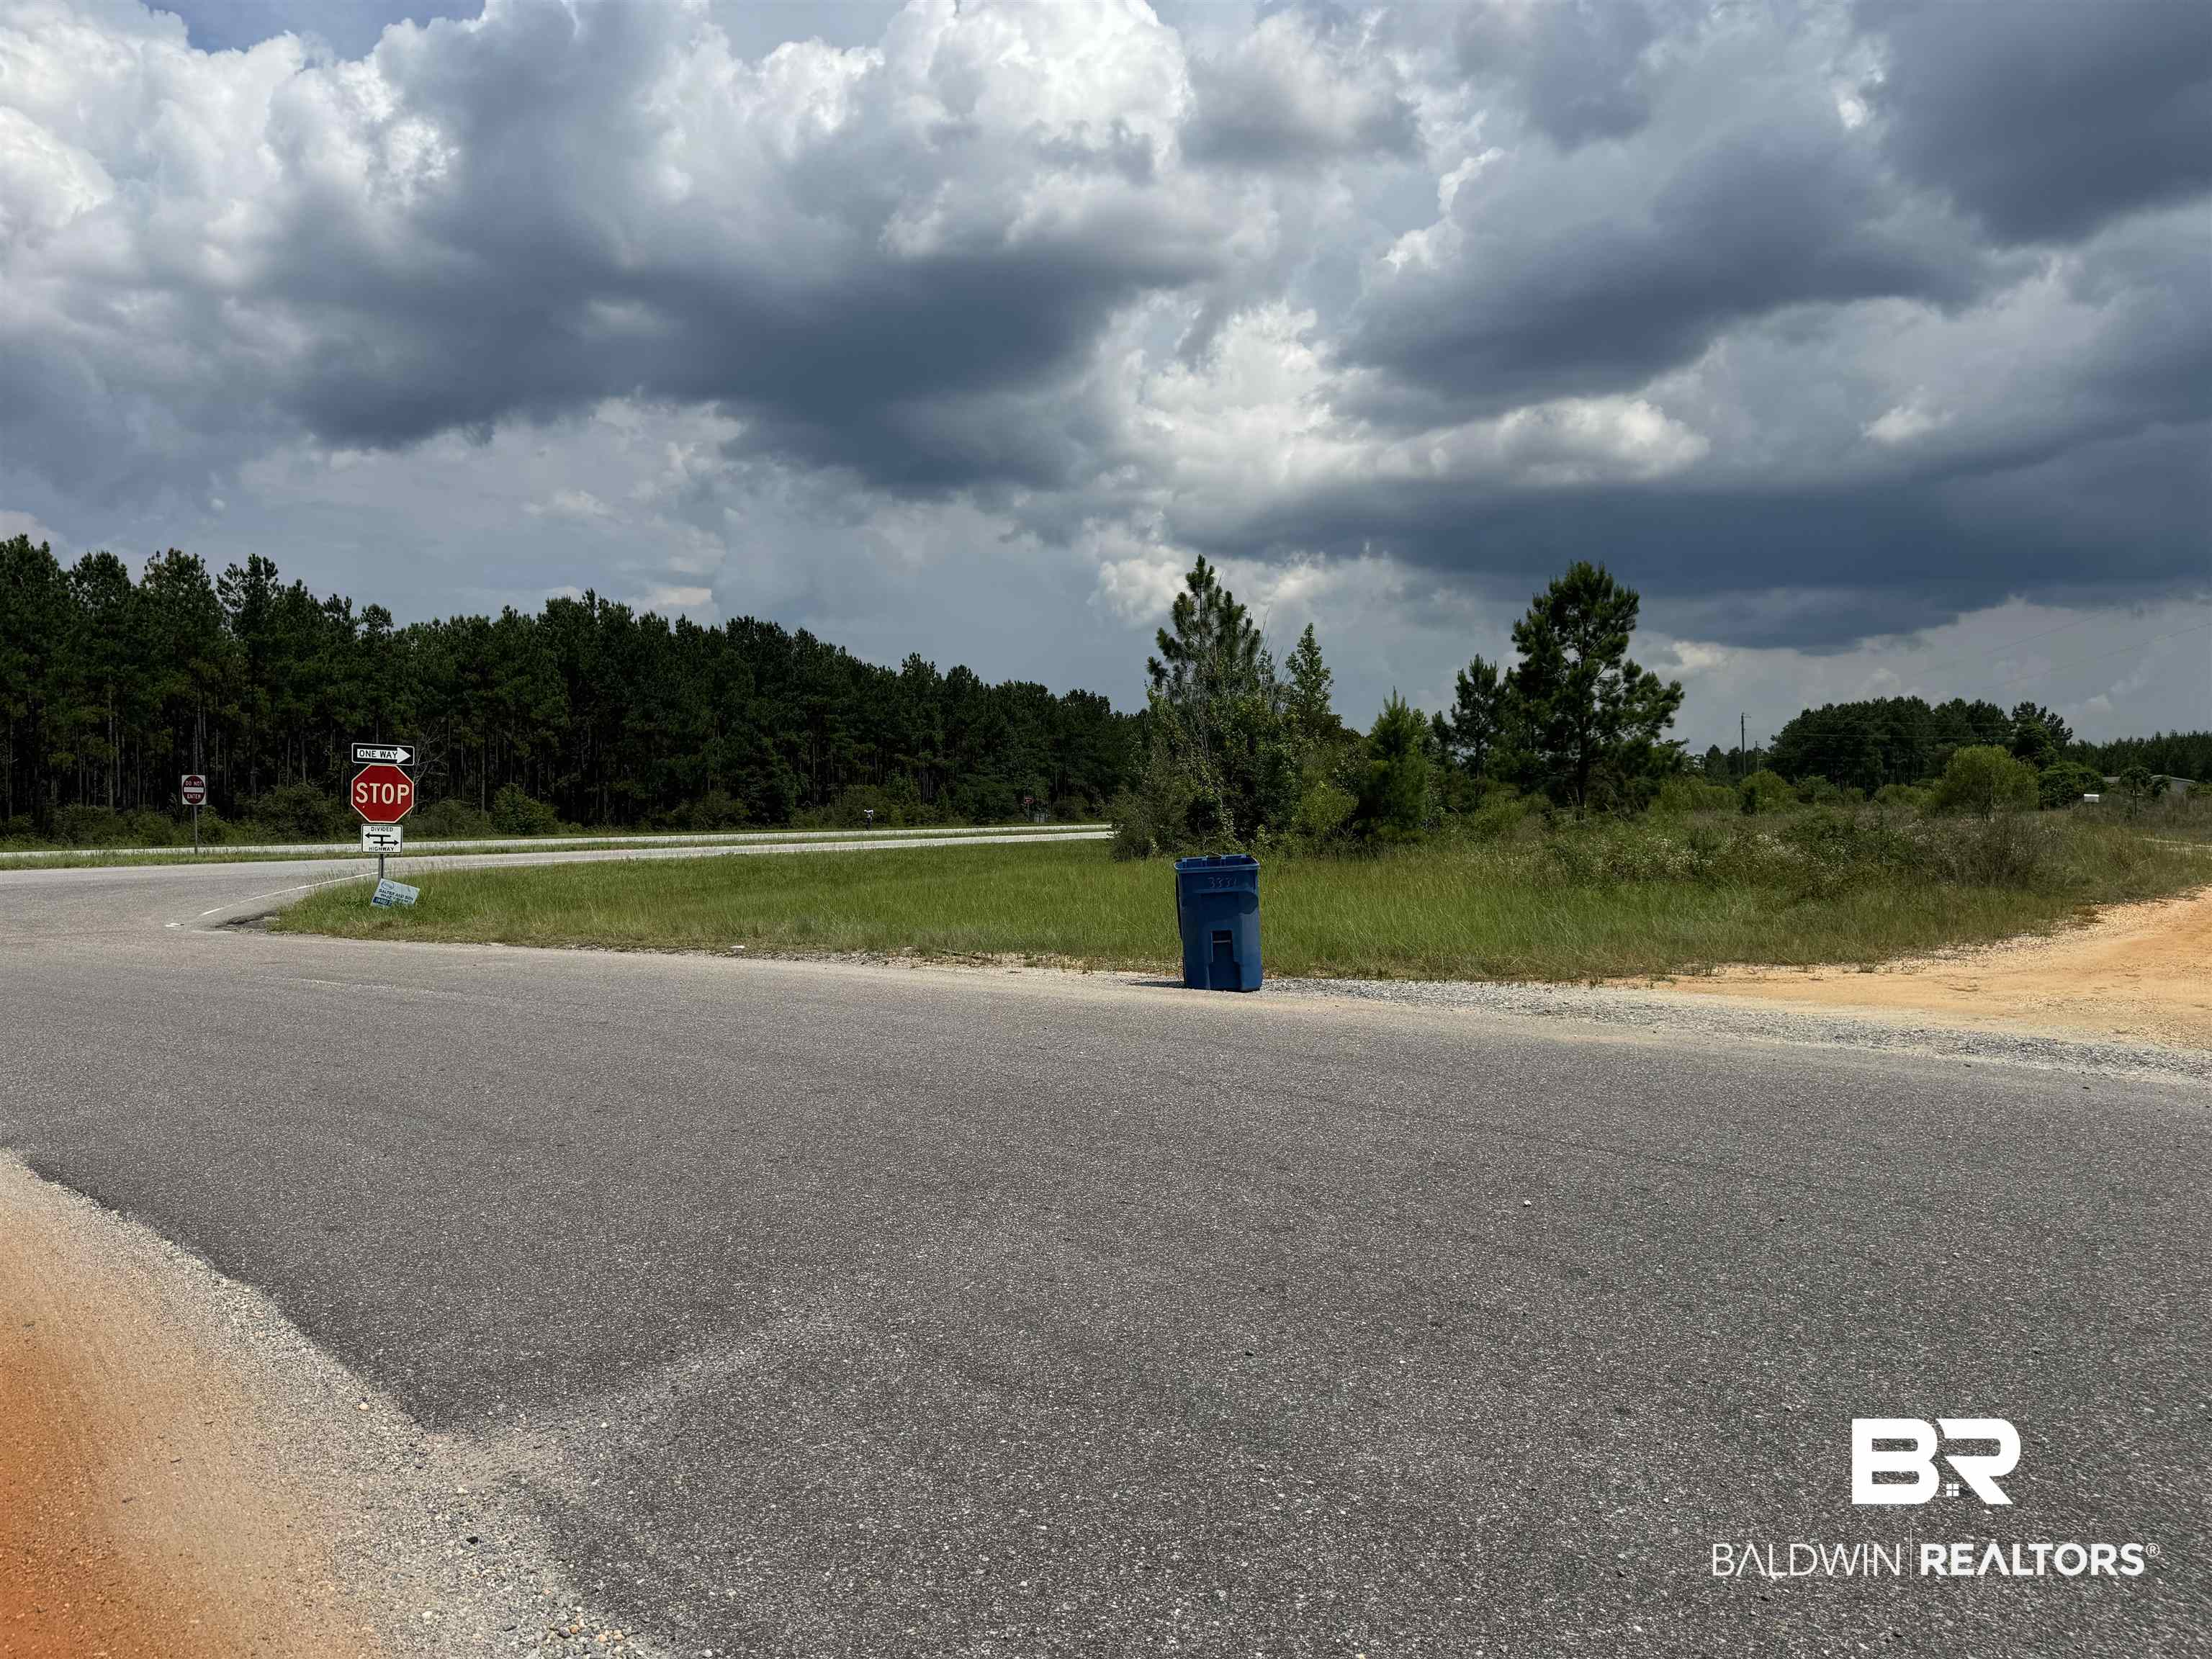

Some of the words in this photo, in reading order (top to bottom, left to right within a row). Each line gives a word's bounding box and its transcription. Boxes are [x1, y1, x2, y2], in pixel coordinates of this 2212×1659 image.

[359, 750, 377, 758] ONE
[379, 750, 397, 759] WAY
[356, 782, 410, 805] STOP
